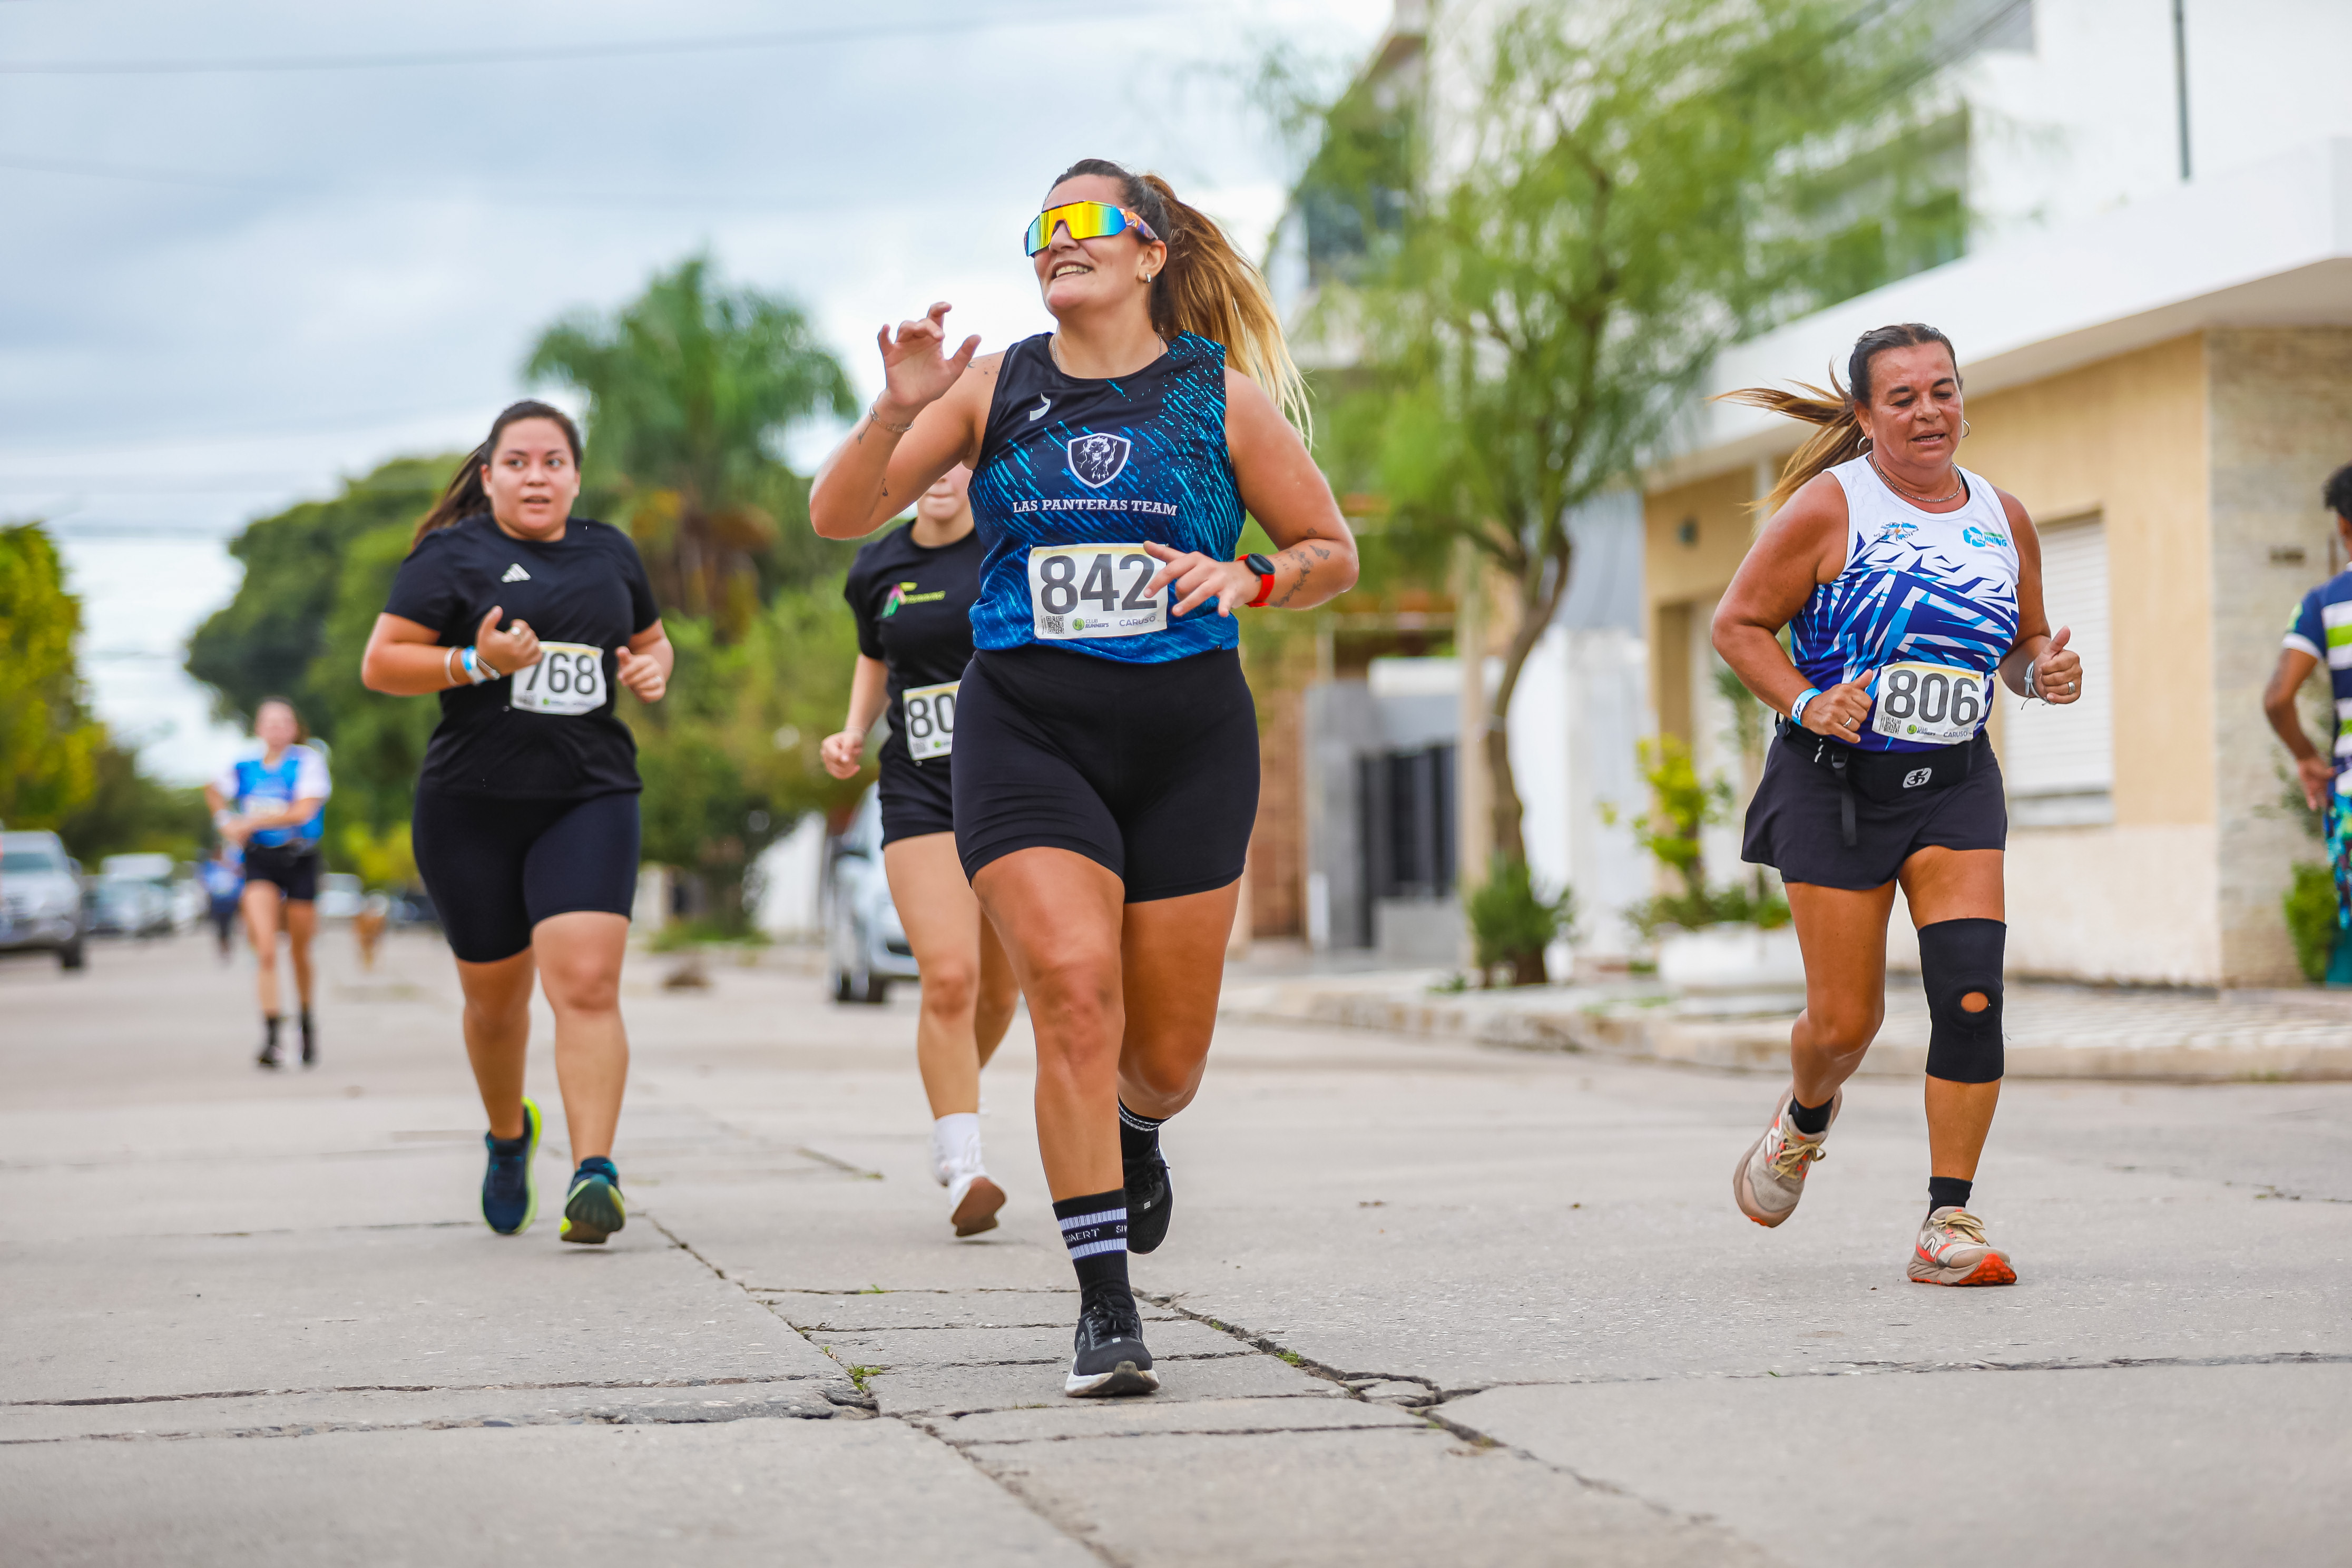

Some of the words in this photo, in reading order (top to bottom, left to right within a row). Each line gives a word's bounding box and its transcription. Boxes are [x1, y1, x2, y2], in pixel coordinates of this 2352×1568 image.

[1012, 499, 1037, 513] LAS
[1042, 498, 1128, 511] PANTERAS
[1131, 500, 1178, 516] TEAM
[1040, 553, 1158, 615] 842
[1119, 615, 1156, 627] CARUSO
[526, 652, 595, 694] 768
[1885, 670, 1979, 726] 806
